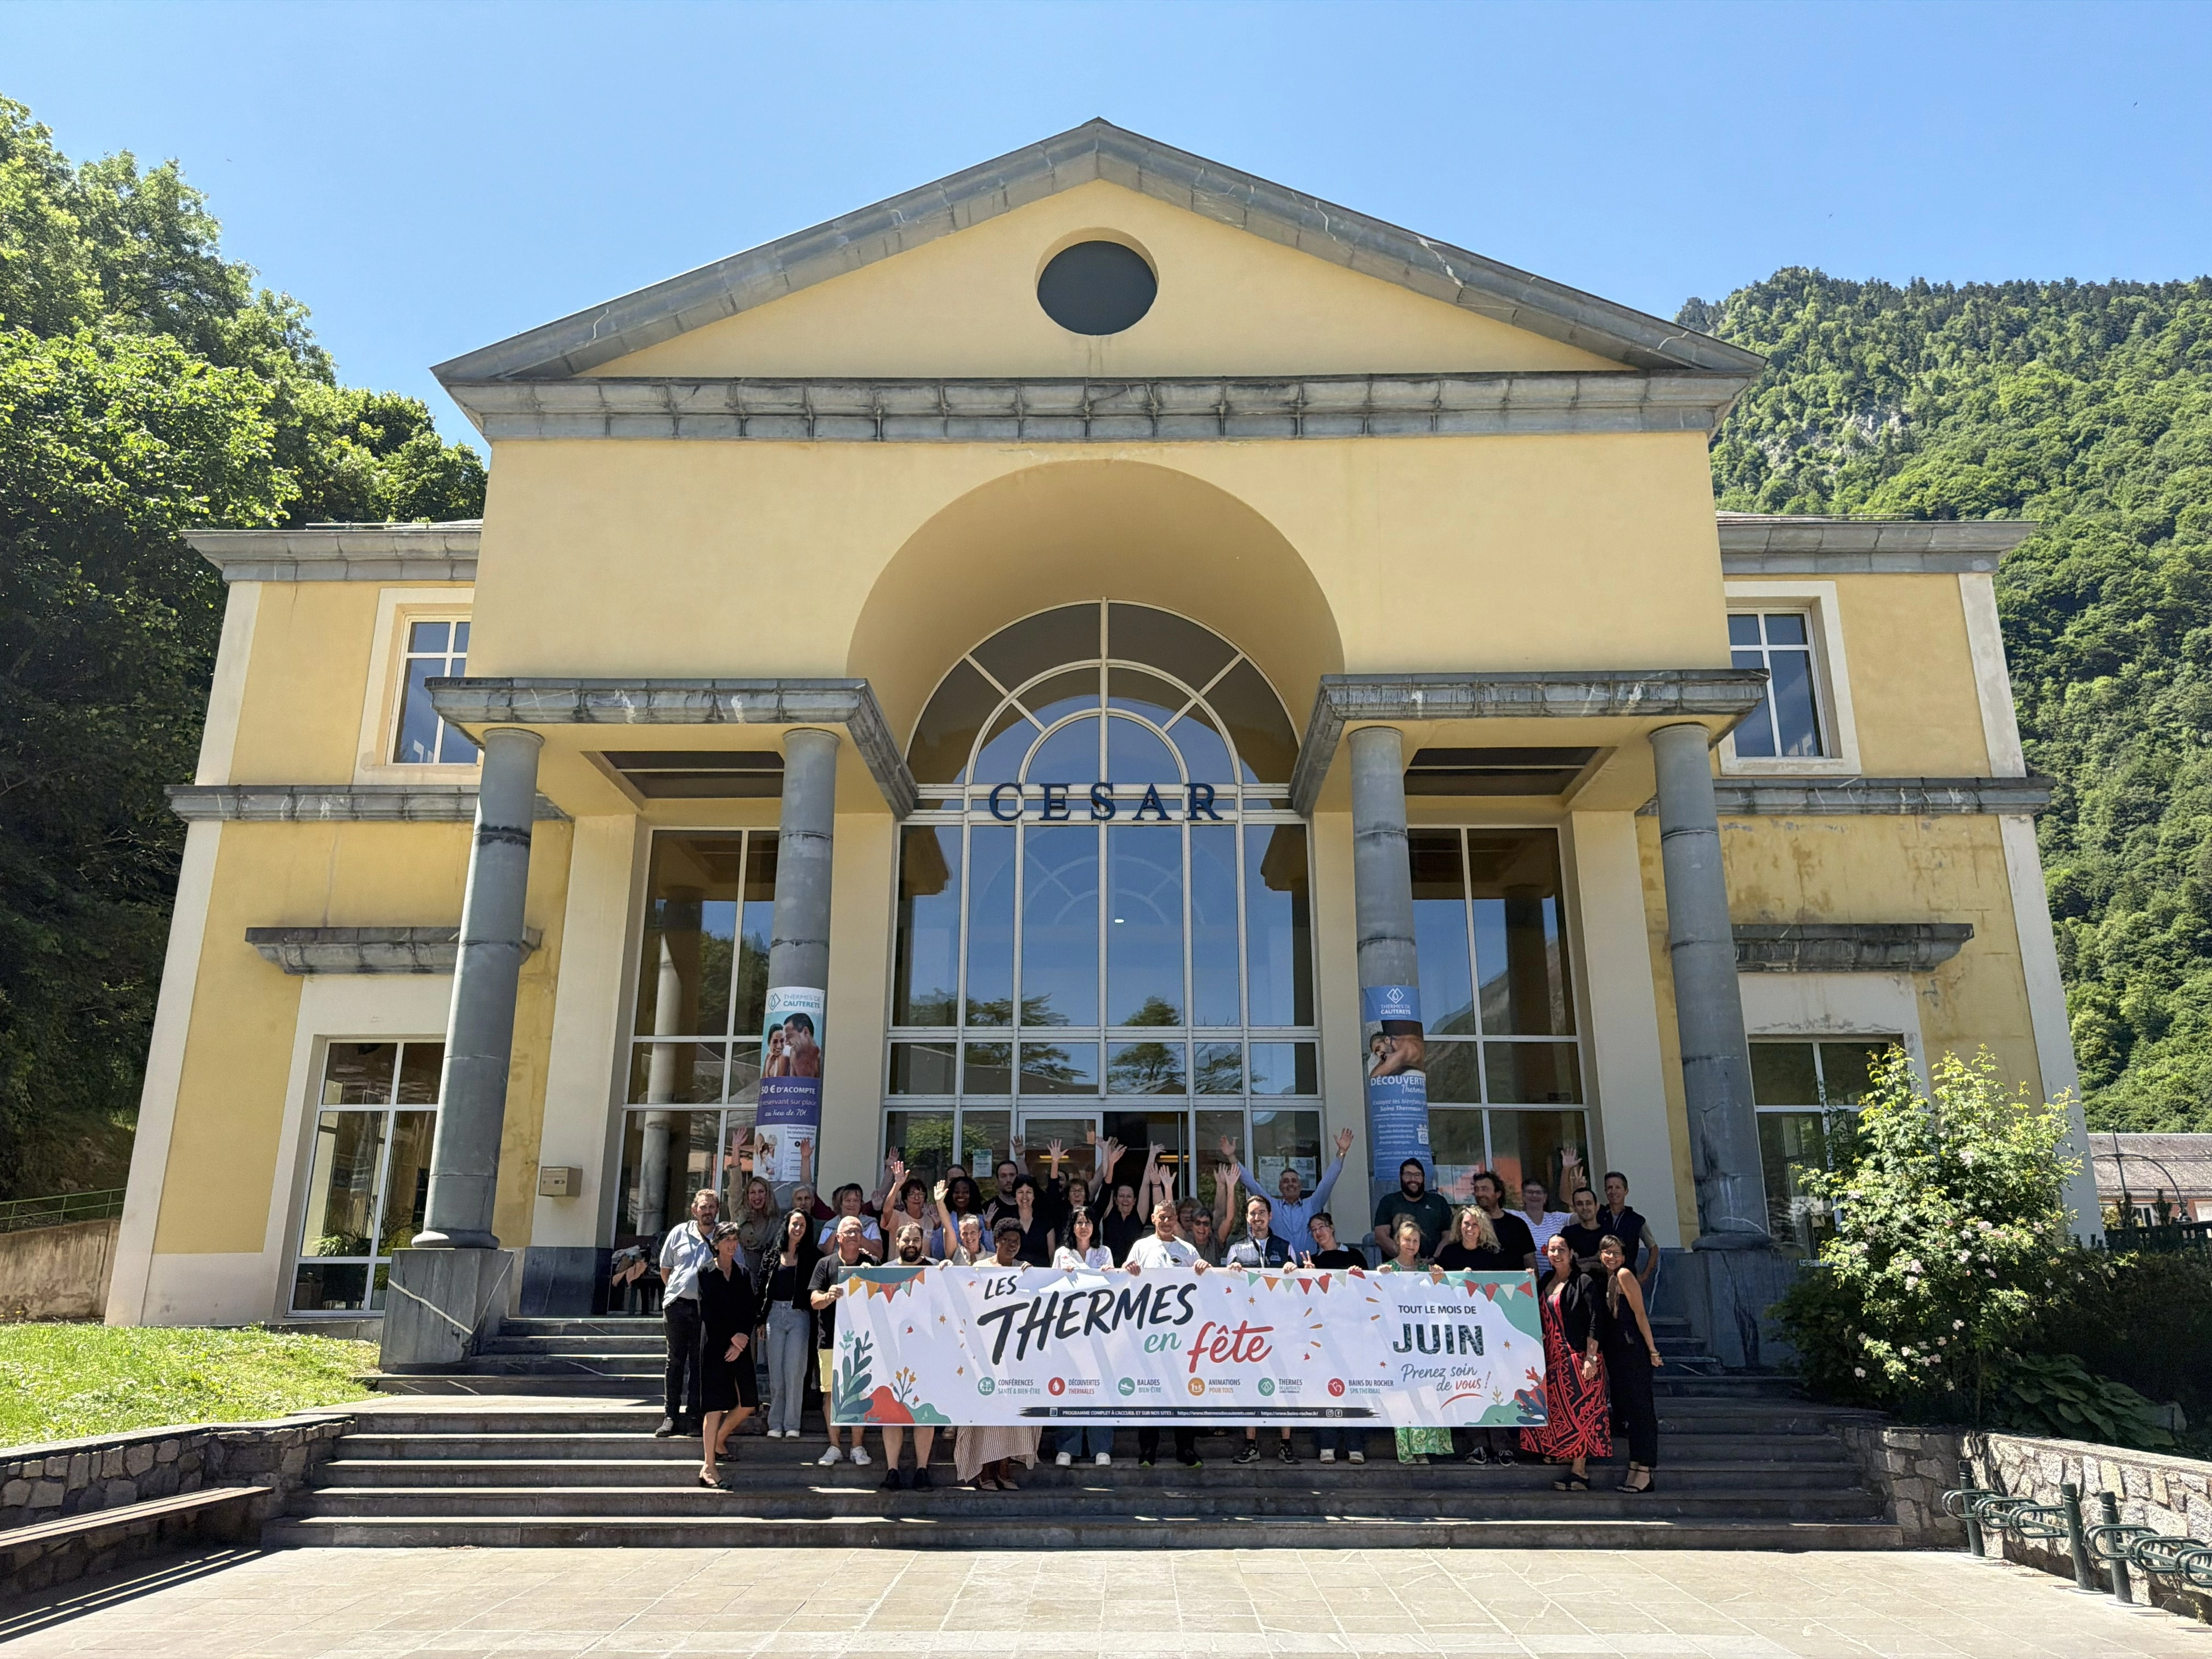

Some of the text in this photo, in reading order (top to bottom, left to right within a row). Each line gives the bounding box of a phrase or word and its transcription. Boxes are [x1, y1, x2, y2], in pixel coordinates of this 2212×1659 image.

[989, 782, 1223, 821] CESAR
[761, 1085, 816, 1094] 50 € D'ACOMPTE
[1370, 1075, 1426, 1086] DÉCOUVERTE
[984, 1275, 1017, 1300] LES
[1398, 1305, 1477, 1314] TOUT LE MOIS DE
[977, 1283, 1197, 1365] THERMES
[1144, 1332, 1182, 1353] en
[1187, 1320, 1274, 1373] fête
[1392, 1323, 1485, 1356] JUIN
[1401, 1363, 1477, 1382] Prenez soin
[1436, 1379, 1453, 1392] de
[1455, 1378, 1482, 1390] vous
